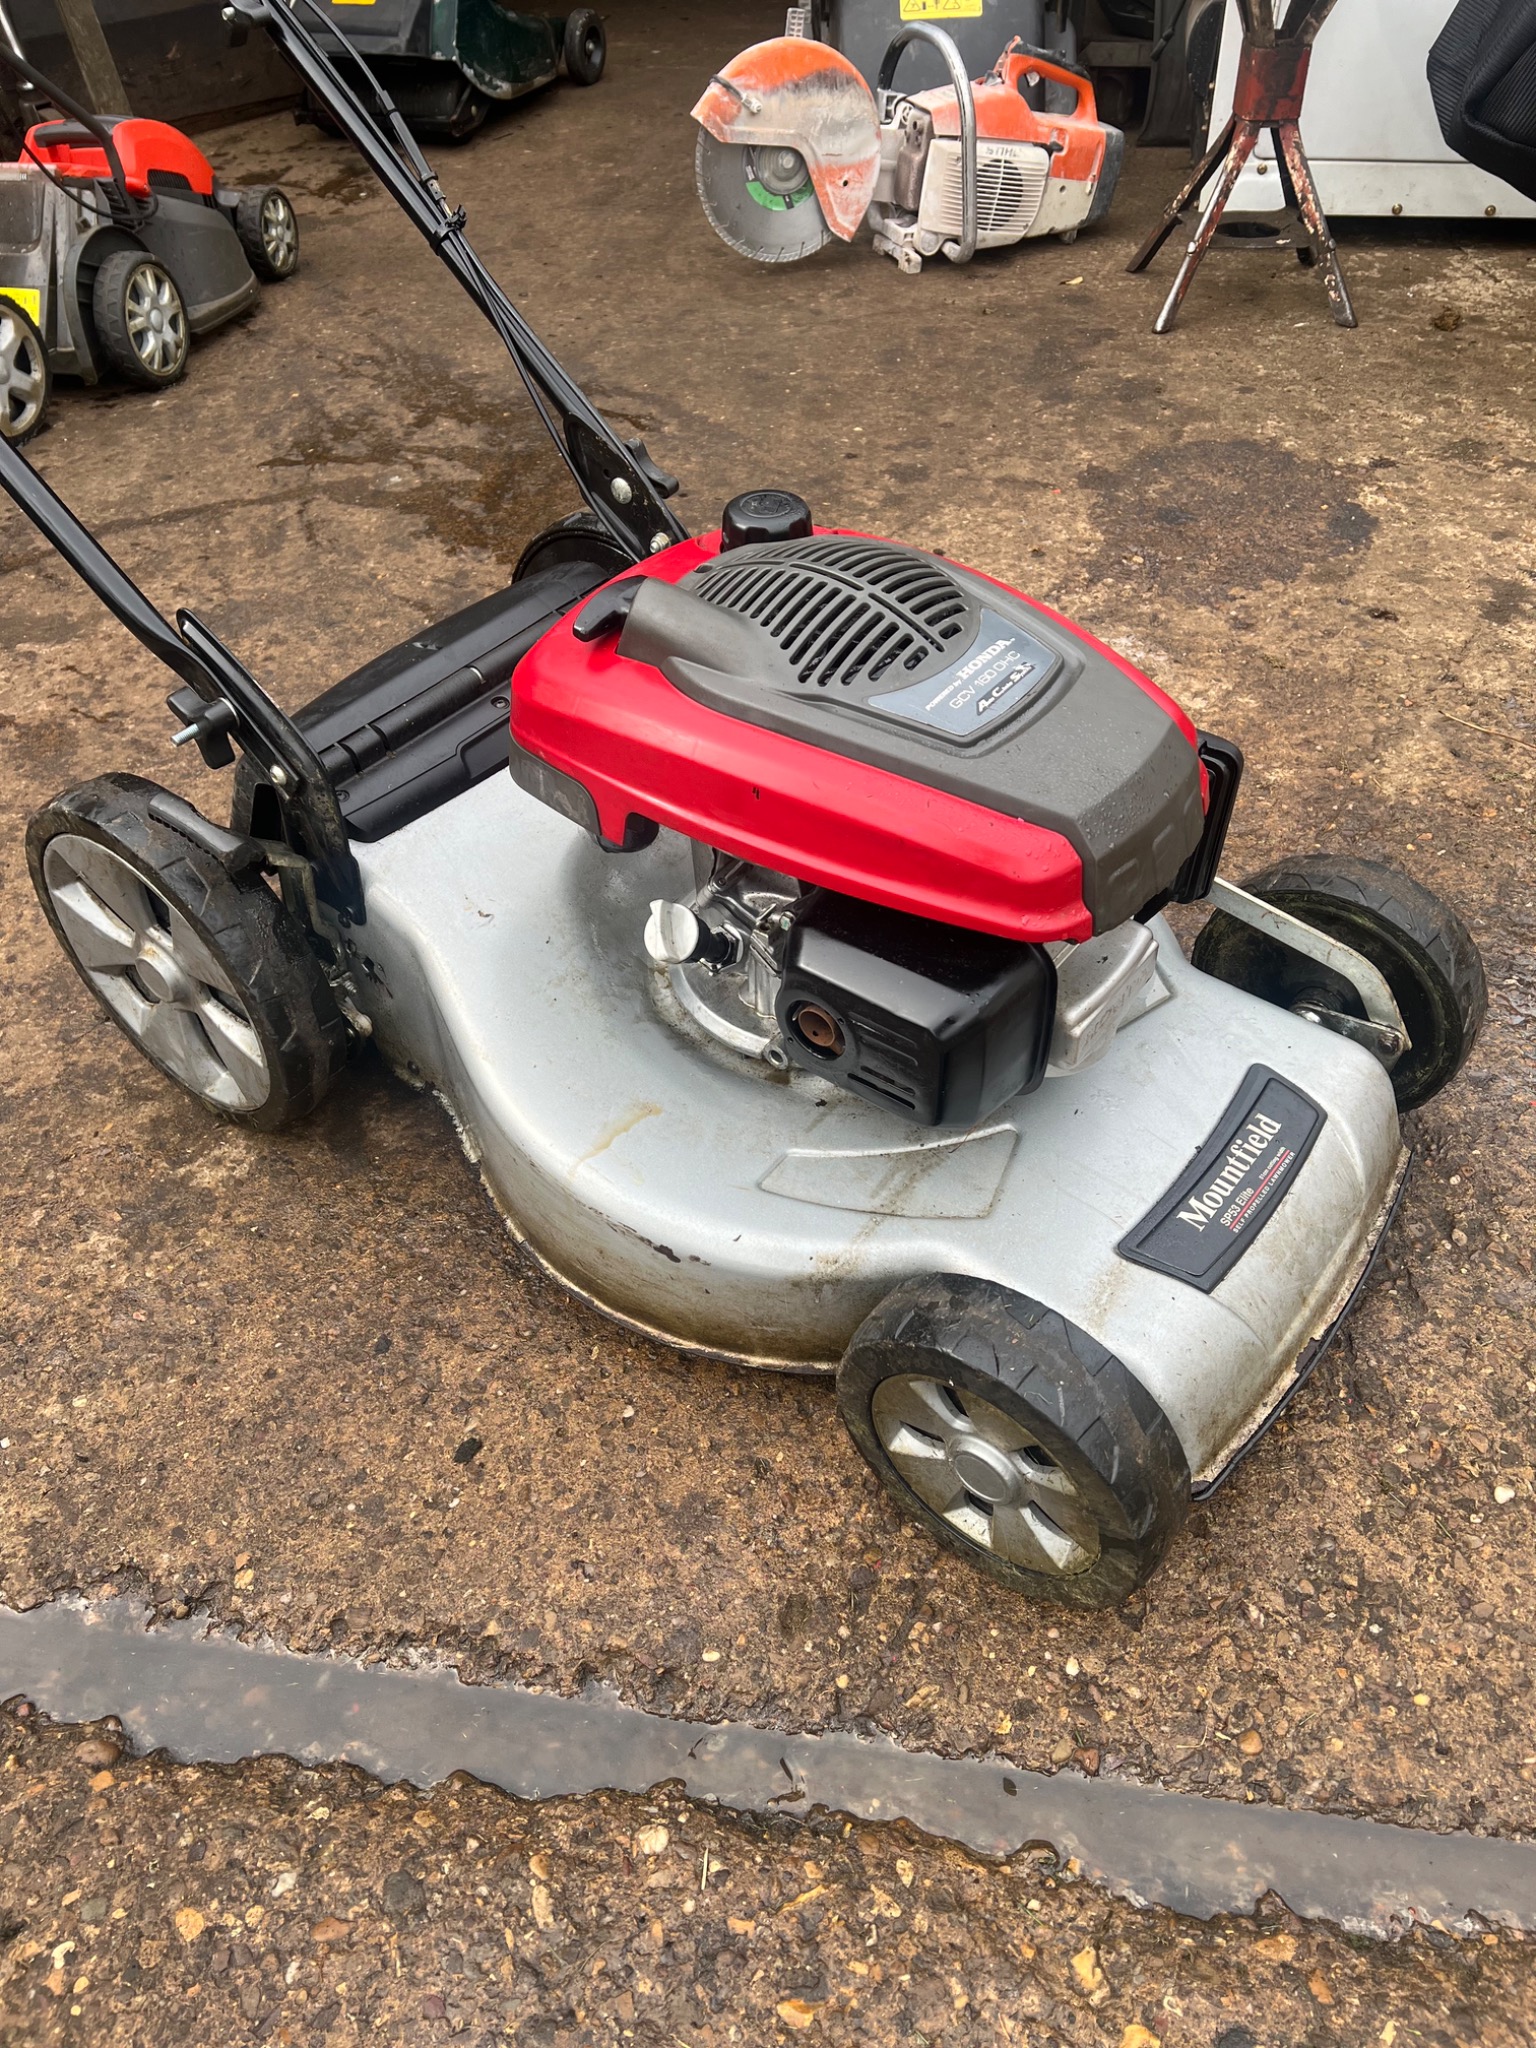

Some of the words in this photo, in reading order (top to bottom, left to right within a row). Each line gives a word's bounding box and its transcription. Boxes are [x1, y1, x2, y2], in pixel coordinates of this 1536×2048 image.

[956, 639, 1011, 679] HONDA
[925, 686, 955, 711] POWERED
[949, 685, 975, 709] GCV
[974, 669, 997, 686] 160
[993, 651, 1020, 671] OHC
[952, 679, 962, 688] by
[1176, 1112, 1282, 1232] Mountfield
[1233, 1217, 1246, 1233] SELF
[1245, 1186, 1271, 1218] PROPELLED
[1268, 1151, 1296, 1187] LAWNMOWER
[1220, 1204, 1241, 1227] SP53
[1235, 1187, 1255, 1206] Elite
